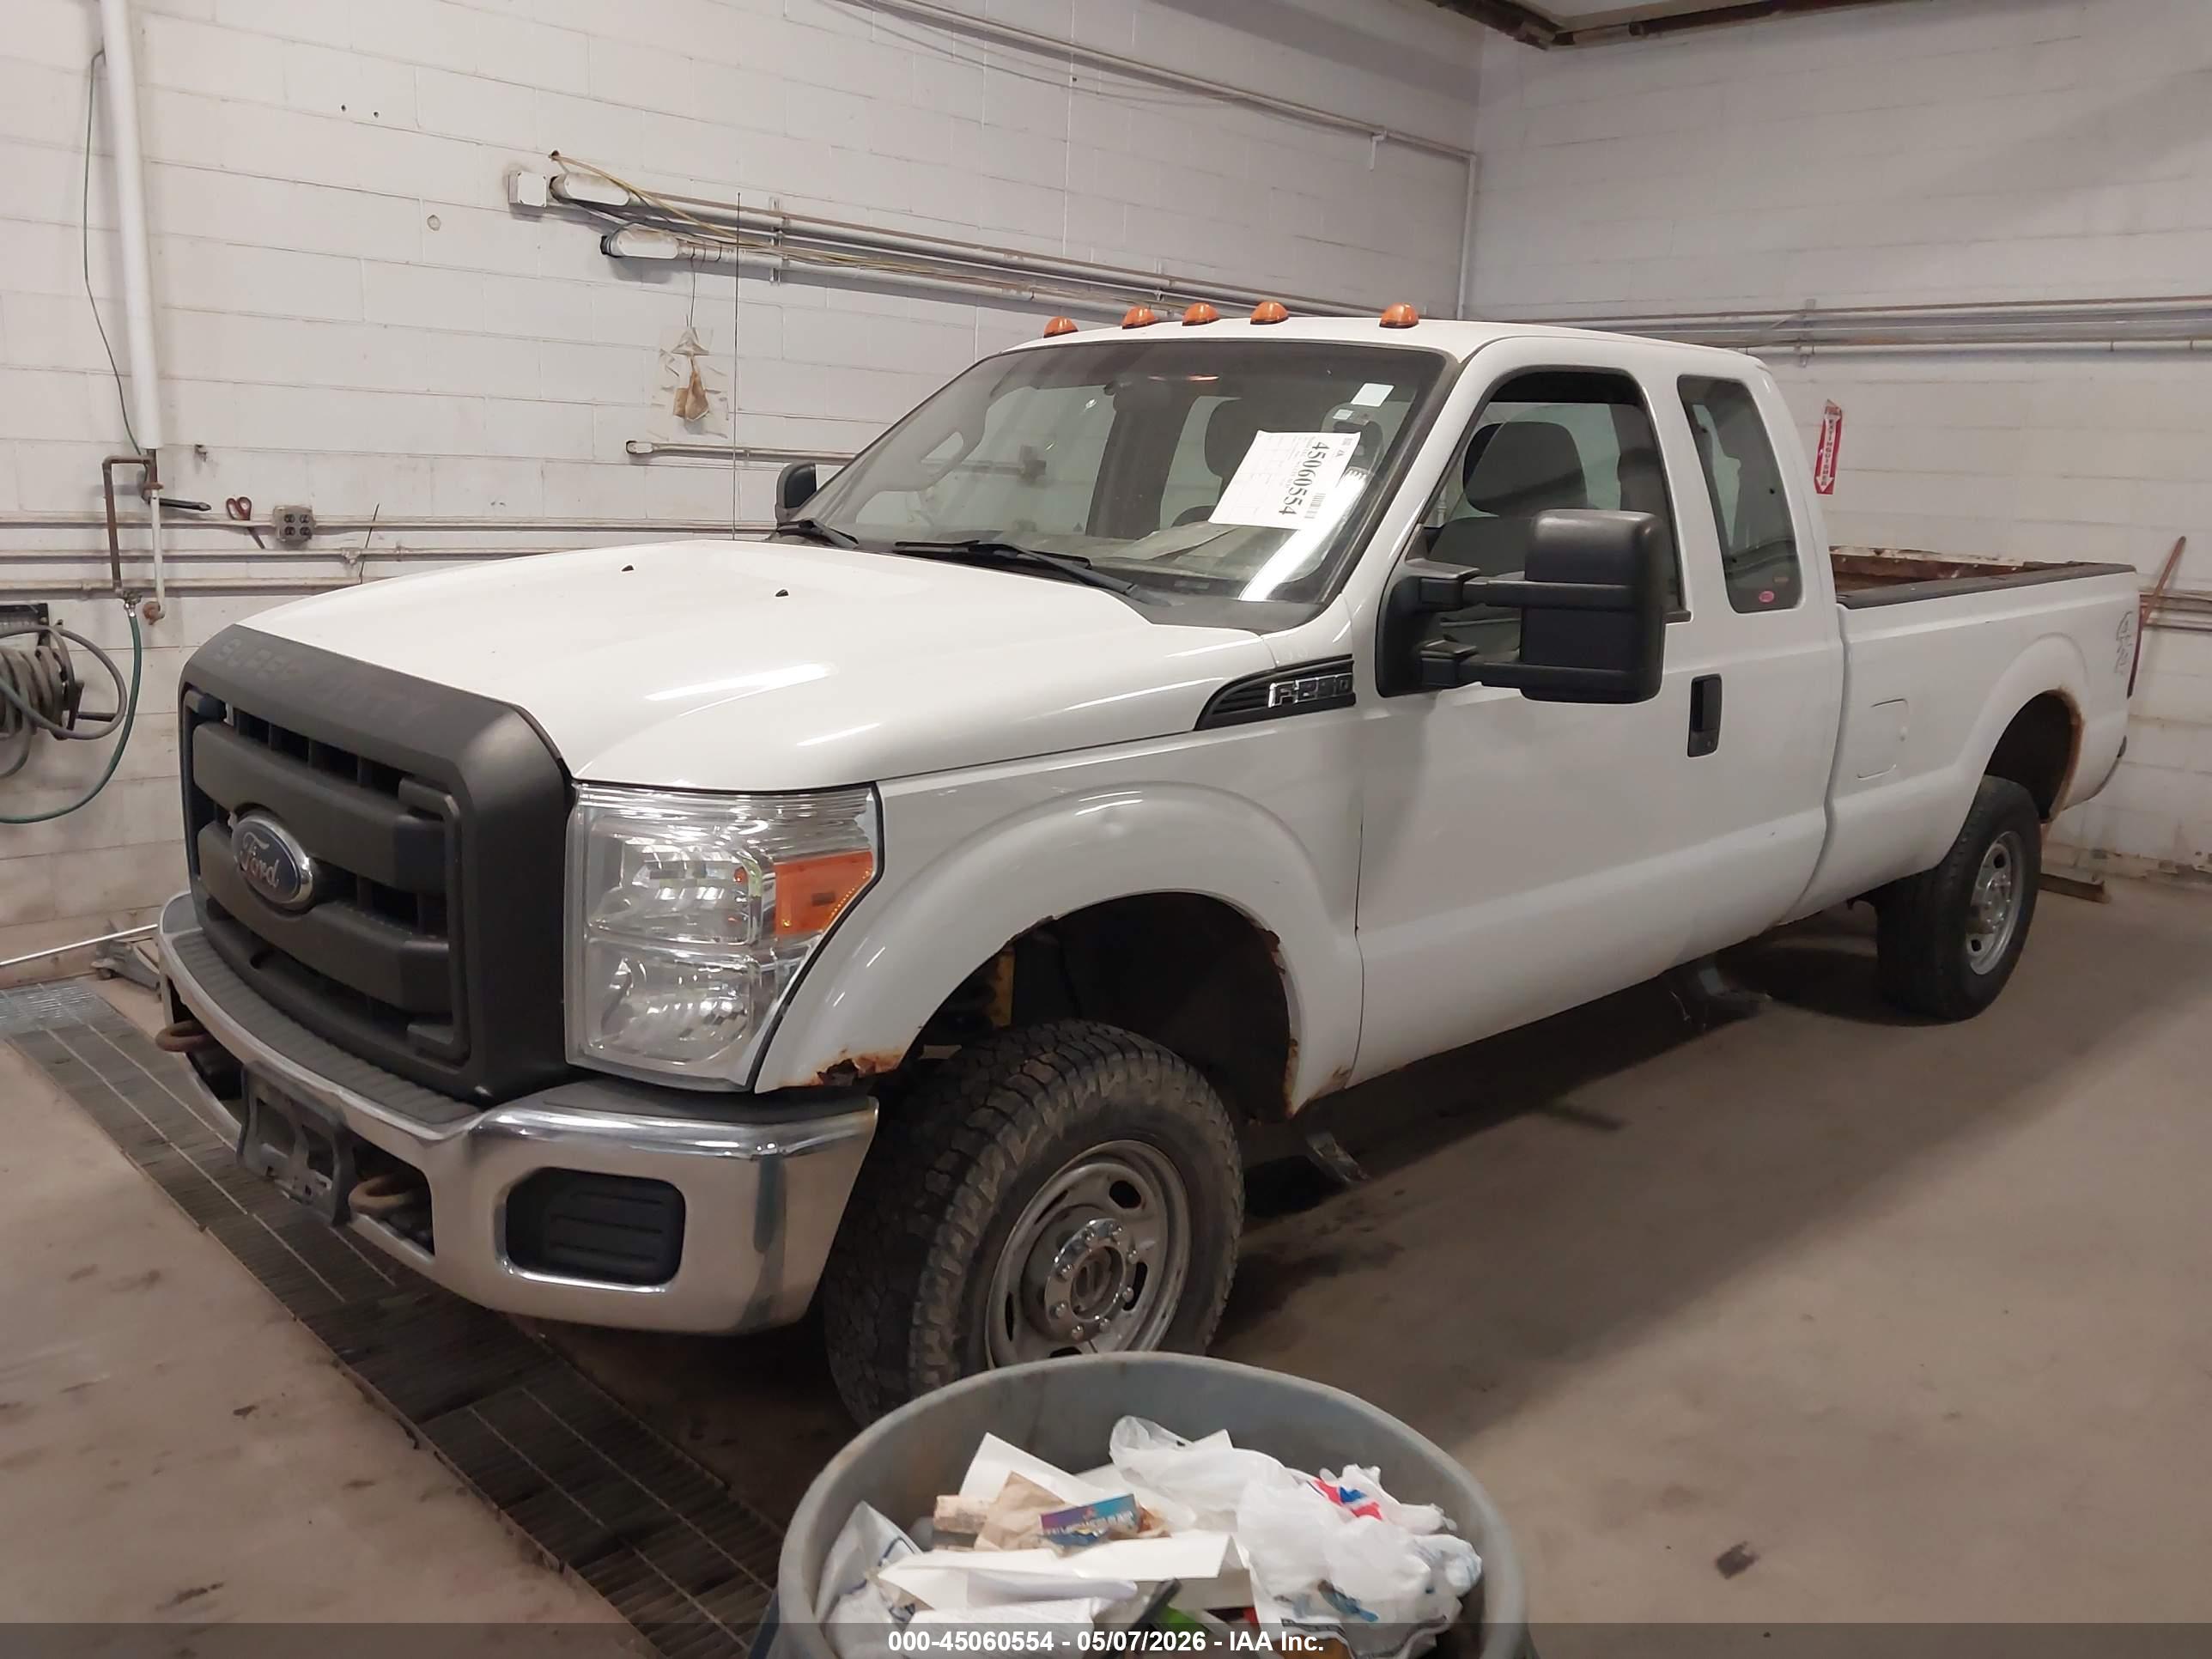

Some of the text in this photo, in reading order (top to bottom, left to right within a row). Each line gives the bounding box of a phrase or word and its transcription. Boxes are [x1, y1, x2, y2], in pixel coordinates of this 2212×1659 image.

[1279, 441, 1329, 515] 45060554
[1820, 419, 1834, 486] EXTINGUISHER
[239, 830, 280, 888] Ford
